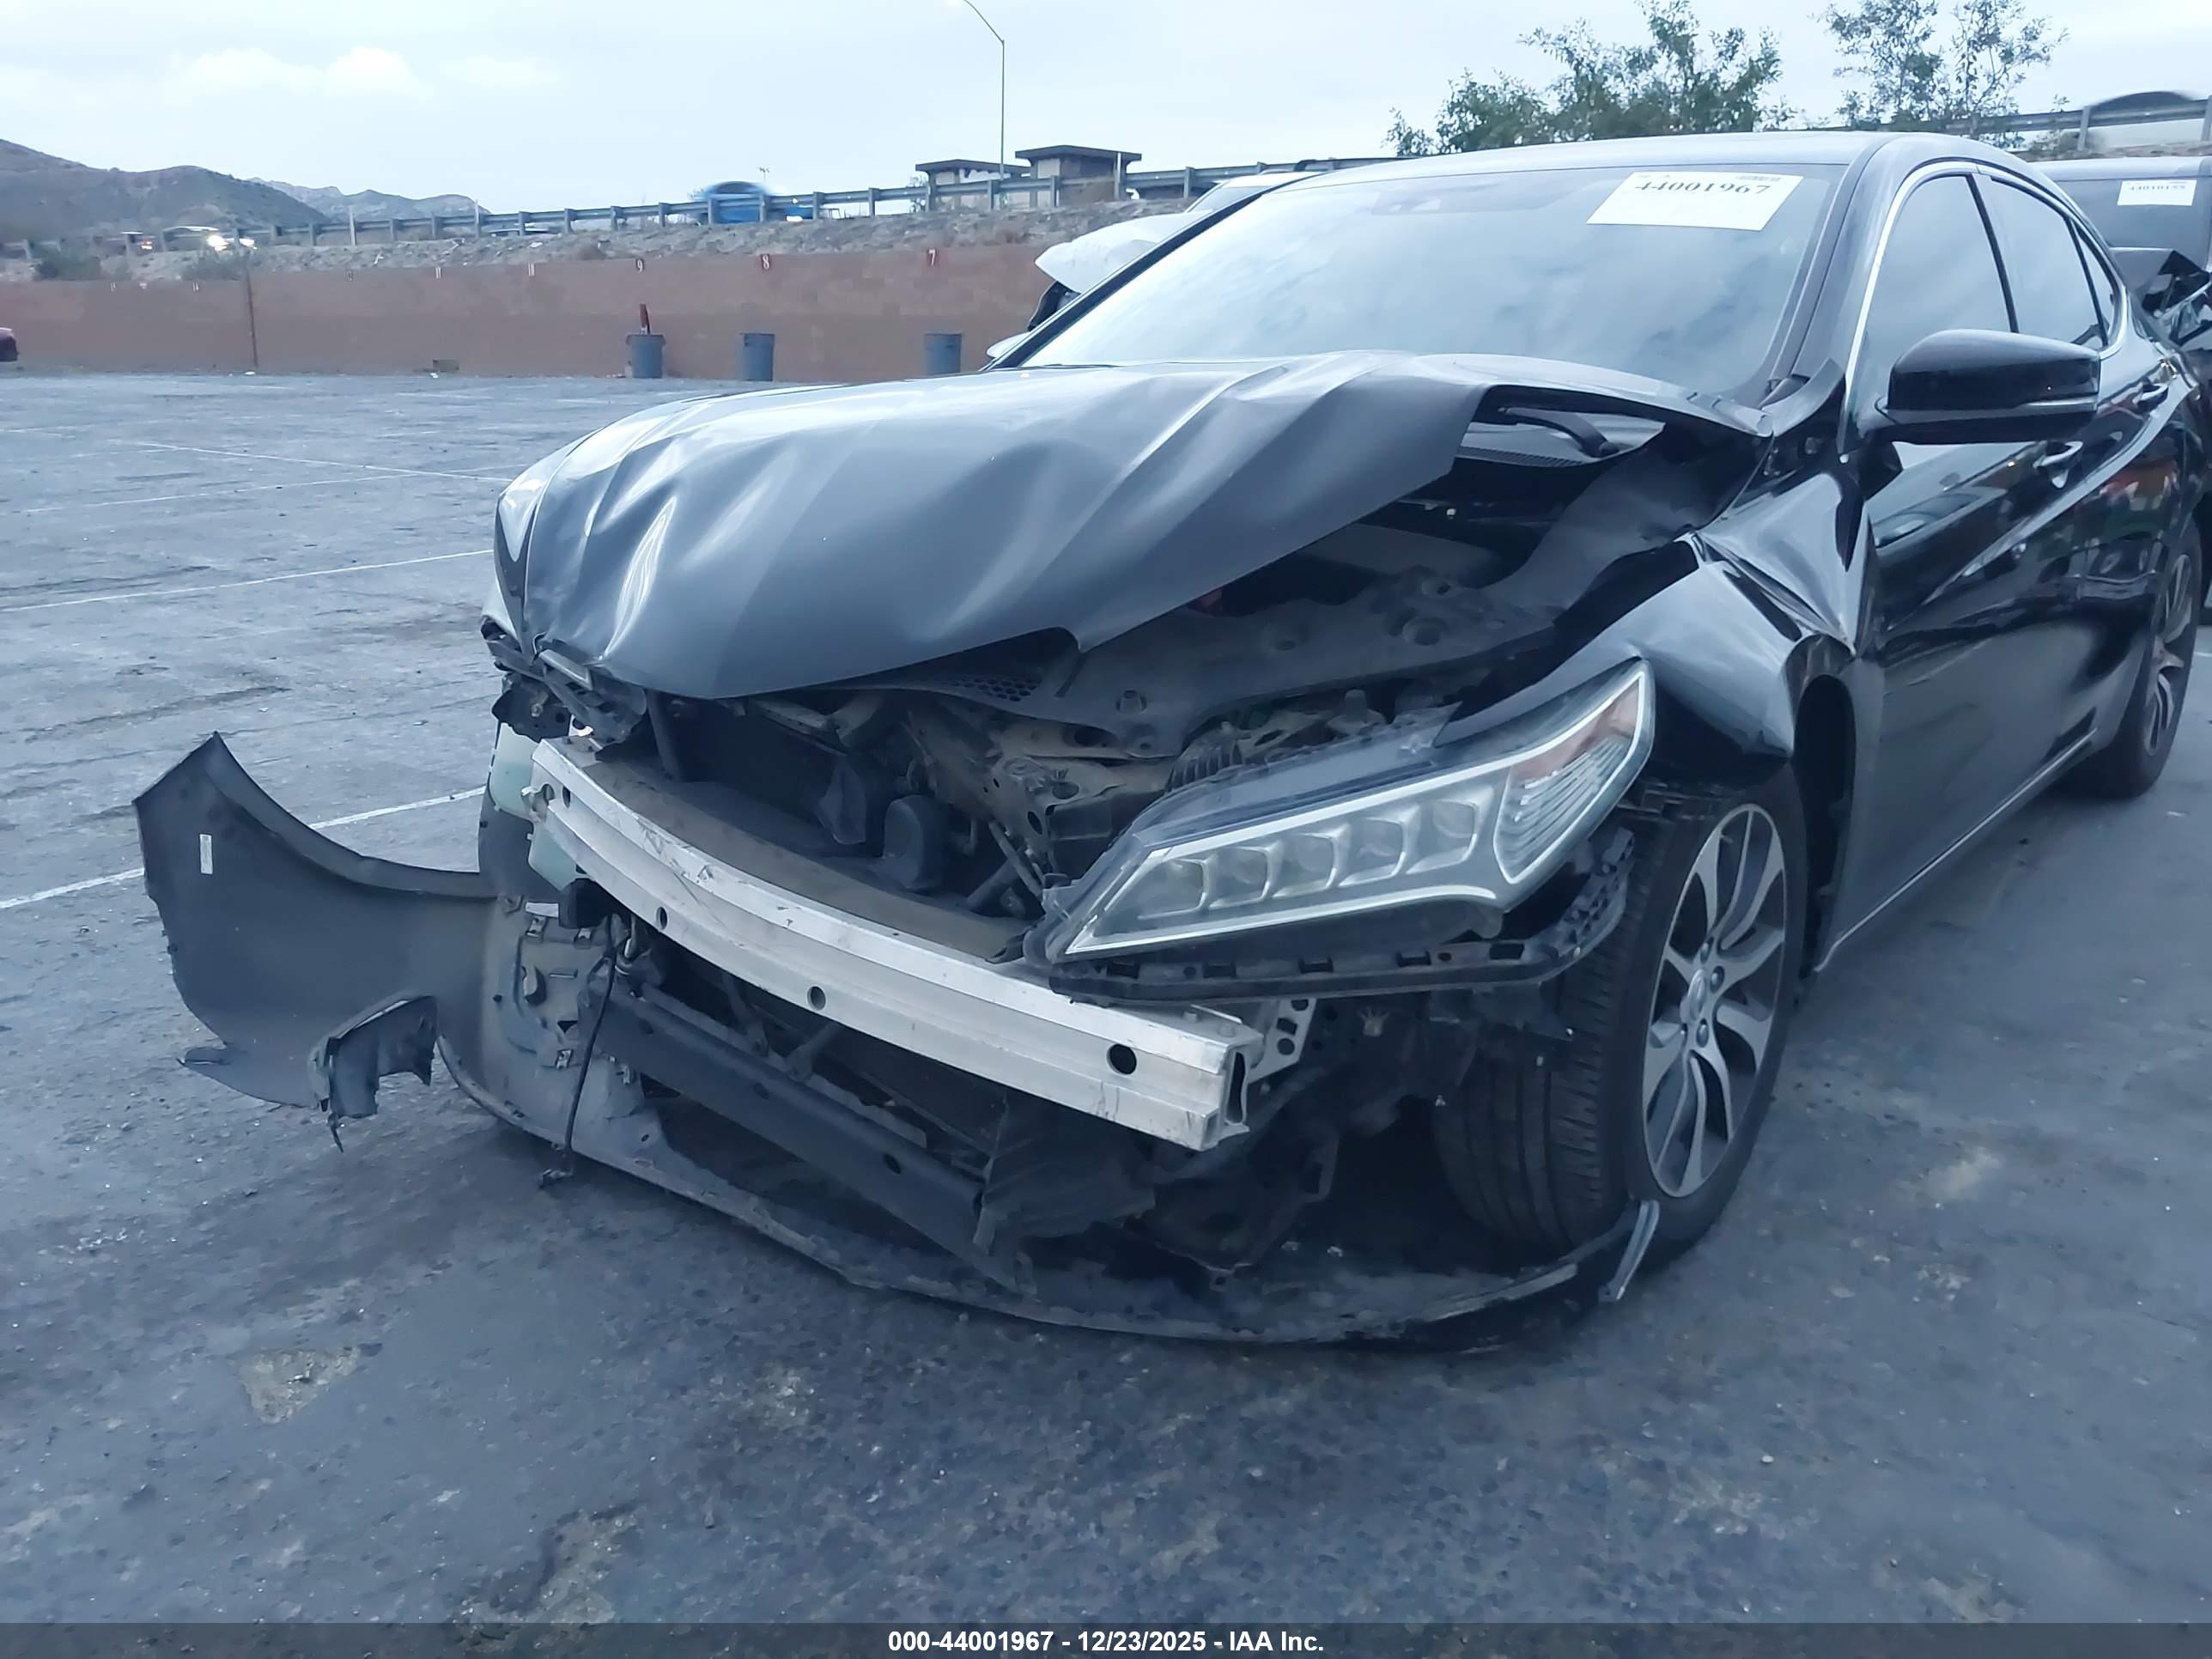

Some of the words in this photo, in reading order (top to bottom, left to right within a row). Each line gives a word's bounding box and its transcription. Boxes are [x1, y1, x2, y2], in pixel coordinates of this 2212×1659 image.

[1635, 181, 1770, 194] 44001967
[762, 254, 770, 270] 8
[928, 249, 936, 266] 7
[637, 259, 644, 273] 9
